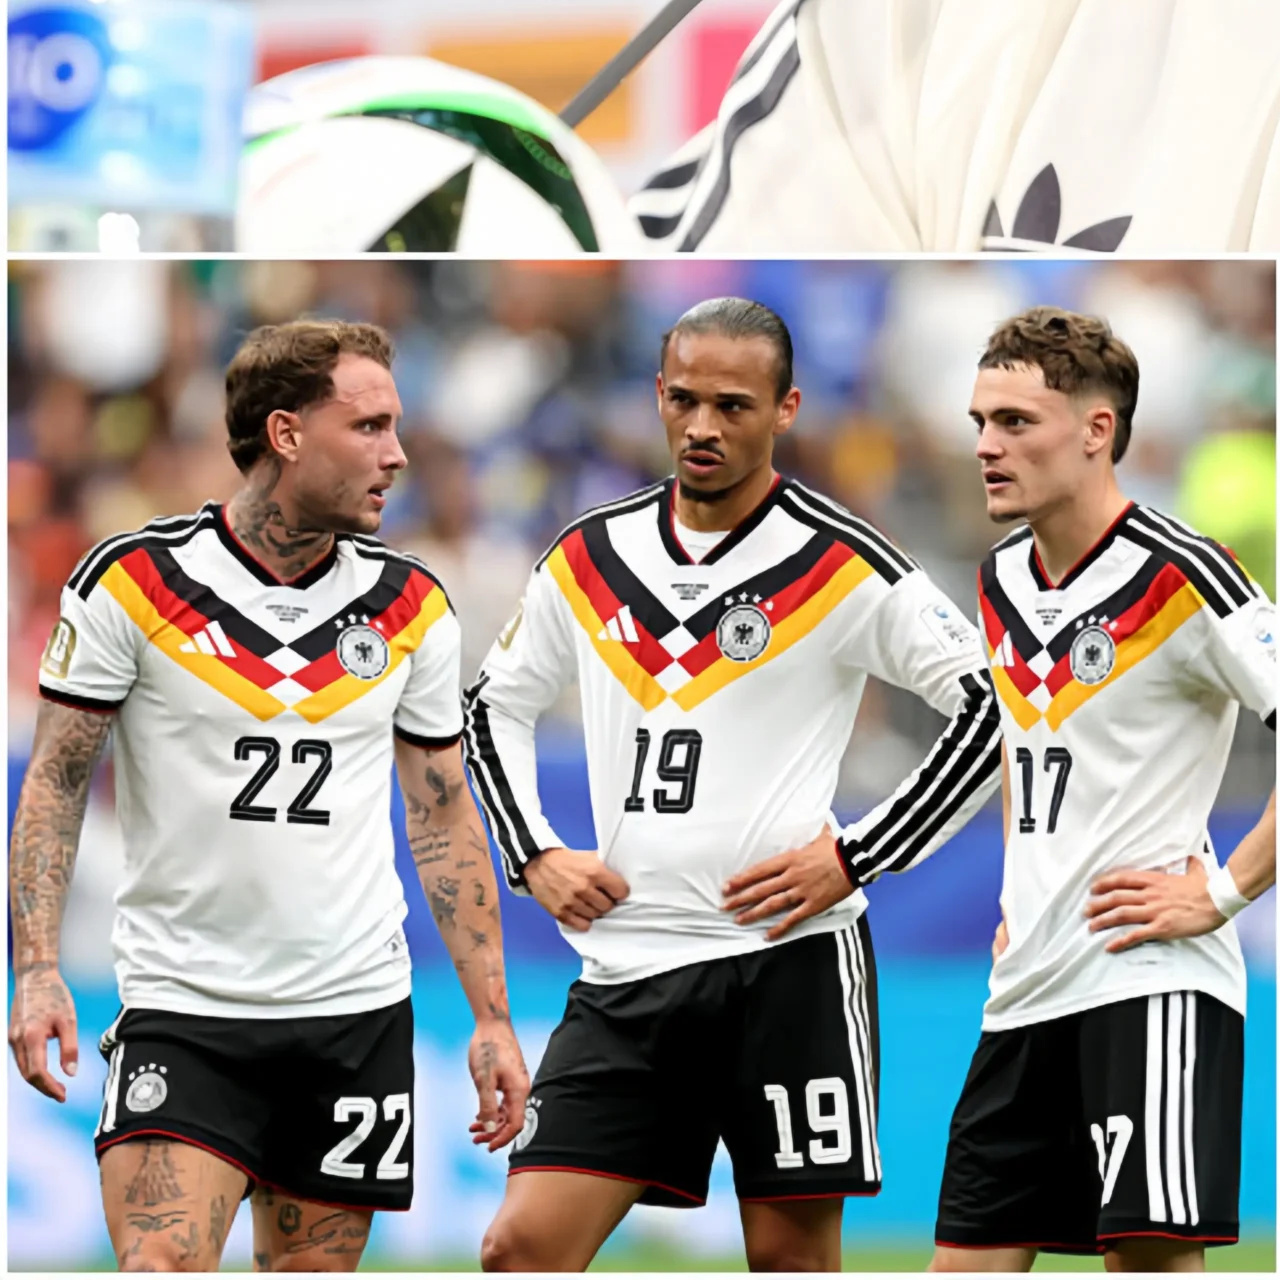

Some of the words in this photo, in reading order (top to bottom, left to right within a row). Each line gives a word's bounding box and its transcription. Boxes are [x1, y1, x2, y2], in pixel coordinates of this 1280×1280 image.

[229, 735, 333, 826] 22
[624, 727, 703, 814] 19
[1015, 746, 1073, 834] 17
[320, 1092, 412, 1180] 22
[763, 1076, 853, 1168] 19
